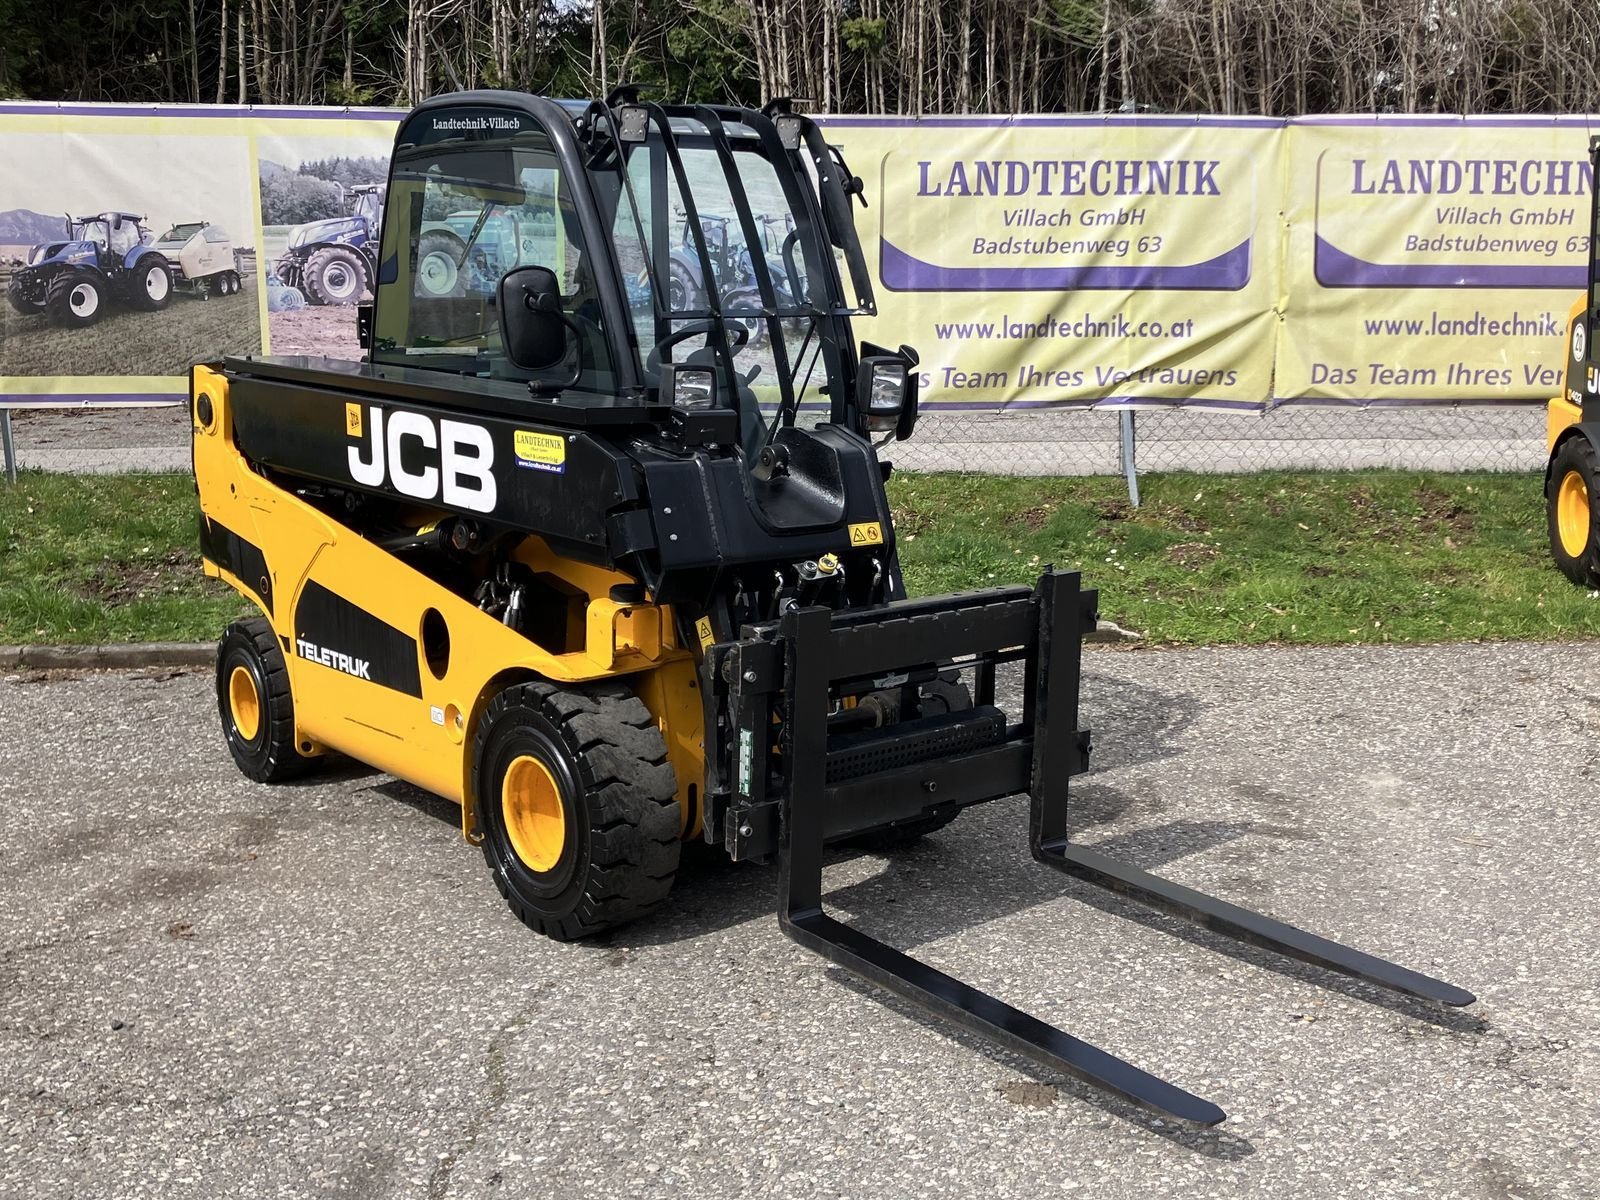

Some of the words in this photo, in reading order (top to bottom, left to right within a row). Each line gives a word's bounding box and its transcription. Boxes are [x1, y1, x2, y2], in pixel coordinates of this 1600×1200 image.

[917, 160, 1221, 197] LANDTECHNIK
[1003, 208, 1072, 227] Villach
[1080, 208, 1146, 226] GmbH
[1436, 207, 1502, 225] Villach
[1509, 208, 1575, 226] GmbH
[972, 236, 1130, 257] Badstubenweg
[1137, 236, 1163, 253] 63
[1405, 235, 1558, 257] Badstubenweg
[1566, 236, 1590, 253] 63
[935, 313, 1194, 339] www.landtechnik.co.at
[1365, 312, 1568, 336] www.landtechnik.
[942, 367, 1008, 388] Team
[1018, 365, 1084, 389] Ihres
[1311, 363, 1357, 385] Das
[1368, 364, 1436, 385] Team
[1447, 363, 1512, 385] Ihres
[516, 433, 563, 450] LANDTECHNIK
[347, 406, 497, 513] JCB
[296, 638, 371, 680] TELETRUK
